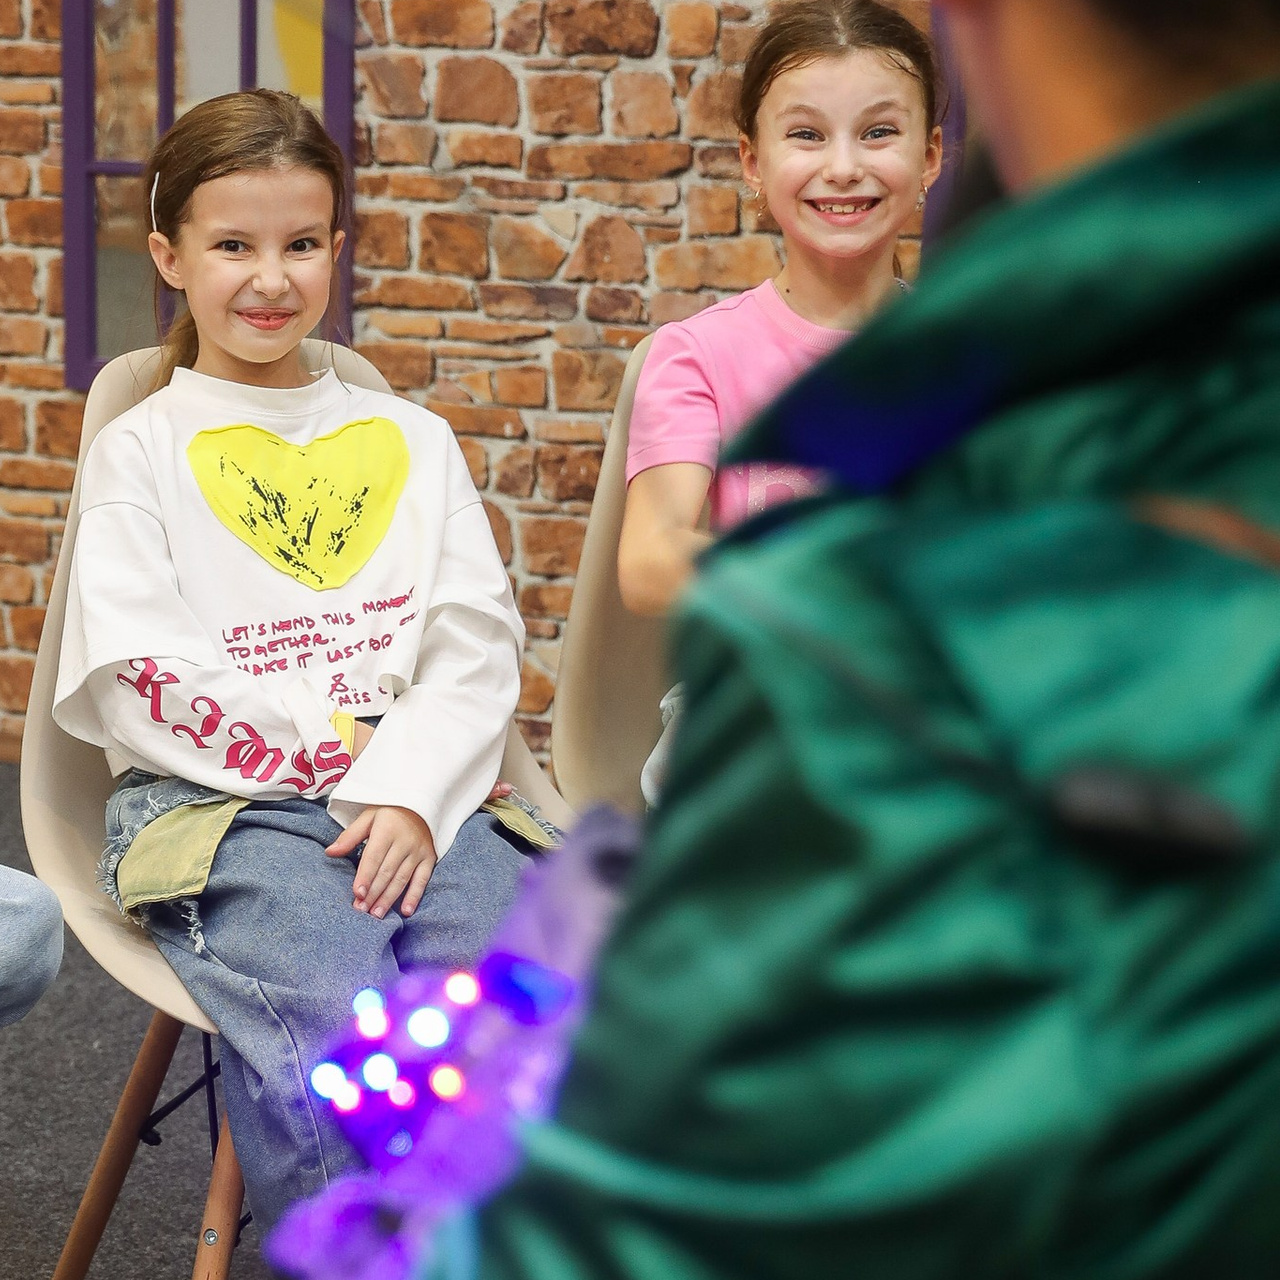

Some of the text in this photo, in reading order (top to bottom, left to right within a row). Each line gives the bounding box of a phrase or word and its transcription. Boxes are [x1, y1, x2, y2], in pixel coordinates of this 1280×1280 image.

[222, 623, 267, 644] LET'S
[321, 612, 355, 626] THIS
[297, 652, 314, 669] IT
[327, 640, 365, 663] LAST
